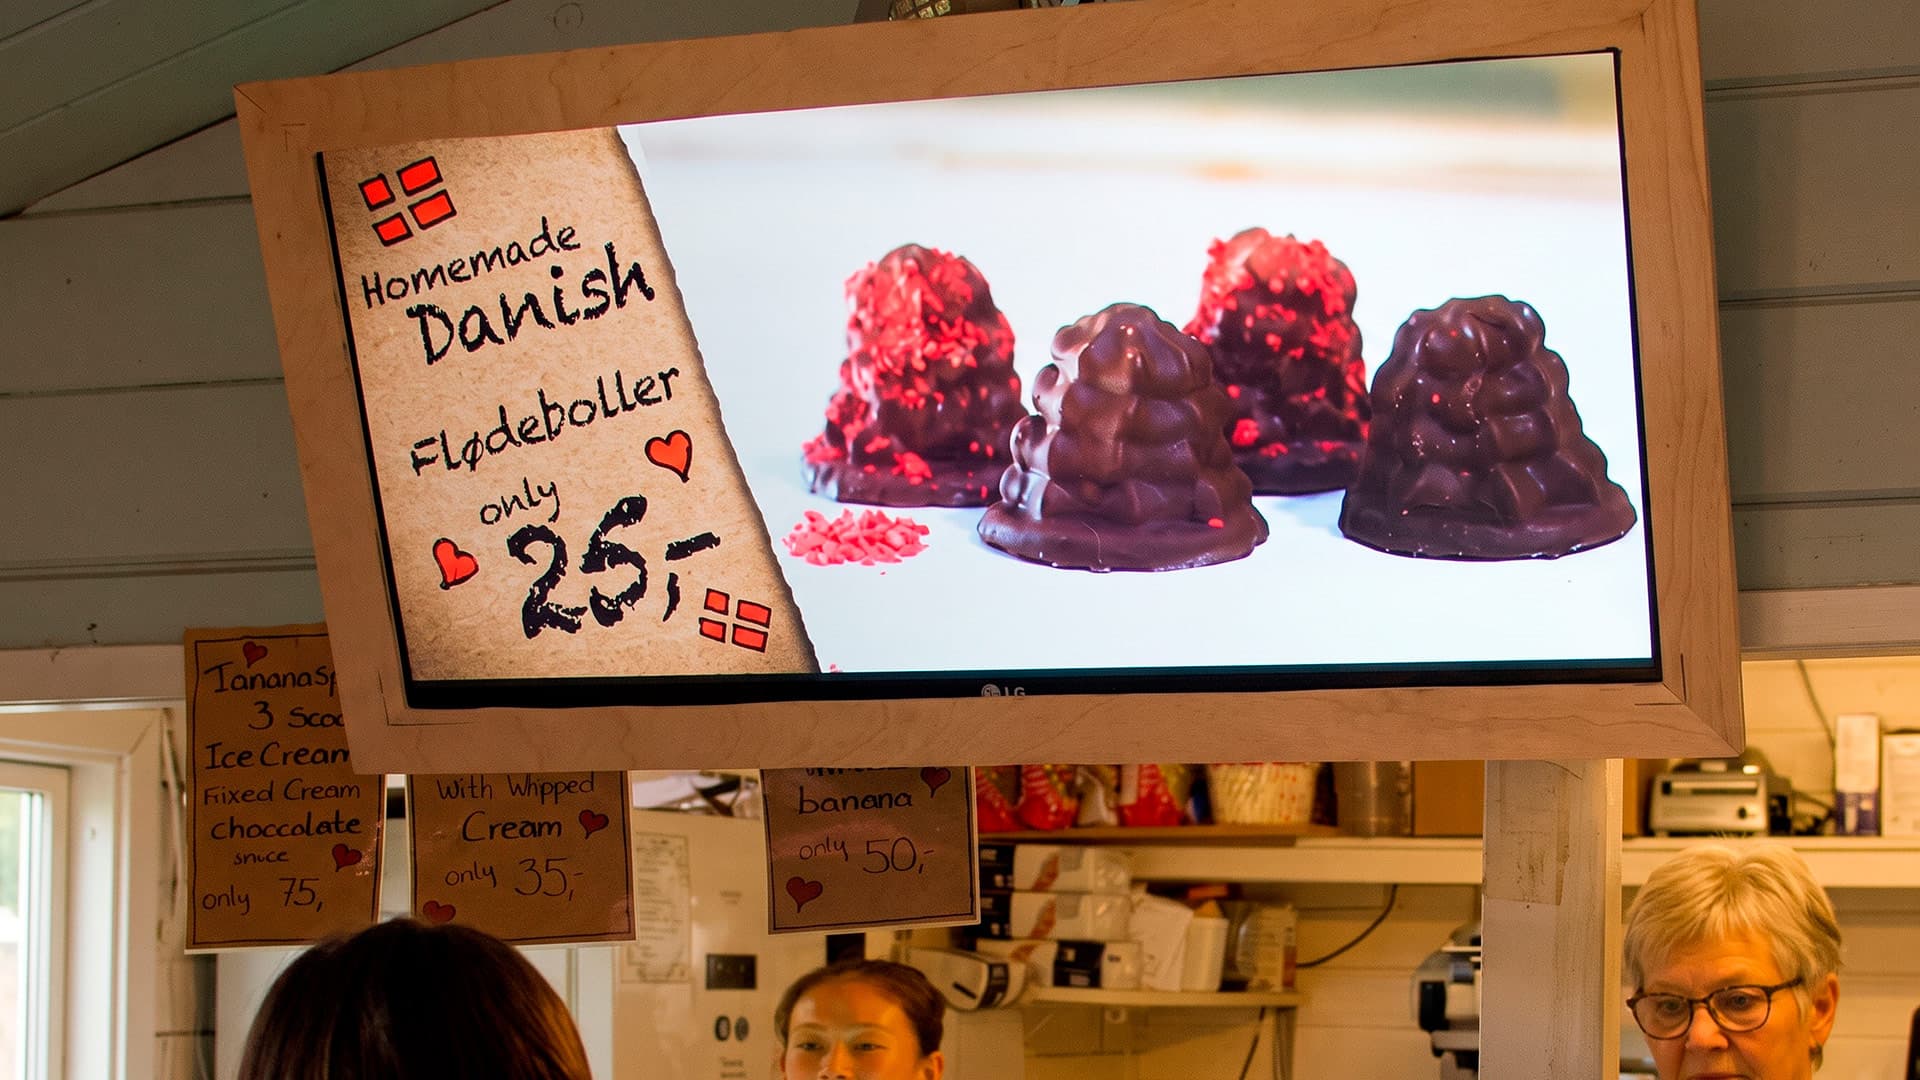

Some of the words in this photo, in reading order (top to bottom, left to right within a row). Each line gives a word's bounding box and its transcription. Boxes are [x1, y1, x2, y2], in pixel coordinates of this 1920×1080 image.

[361, 215, 581, 309] Homemade
[406, 240, 655, 365] Danish
[410, 367, 680, 476] Flødeboller
[479, 476, 561, 526] only
[506, 494, 721, 640] 25,-
[248, 700, 274, 730] 3
[205, 742, 255, 770] Ice
[283, 778, 361, 801] Cream
[436, 774, 493, 800] With
[507, 771, 595, 805] Whipped
[798, 785, 913, 815] banana
[462, 810, 563, 842] Cream
[799, 836, 849, 862] only
[863, 836, 935, 874] 50,-
[445, 861, 497, 888] only
[514, 857, 584, 901] 35,-
[201, 884, 251, 916] only
